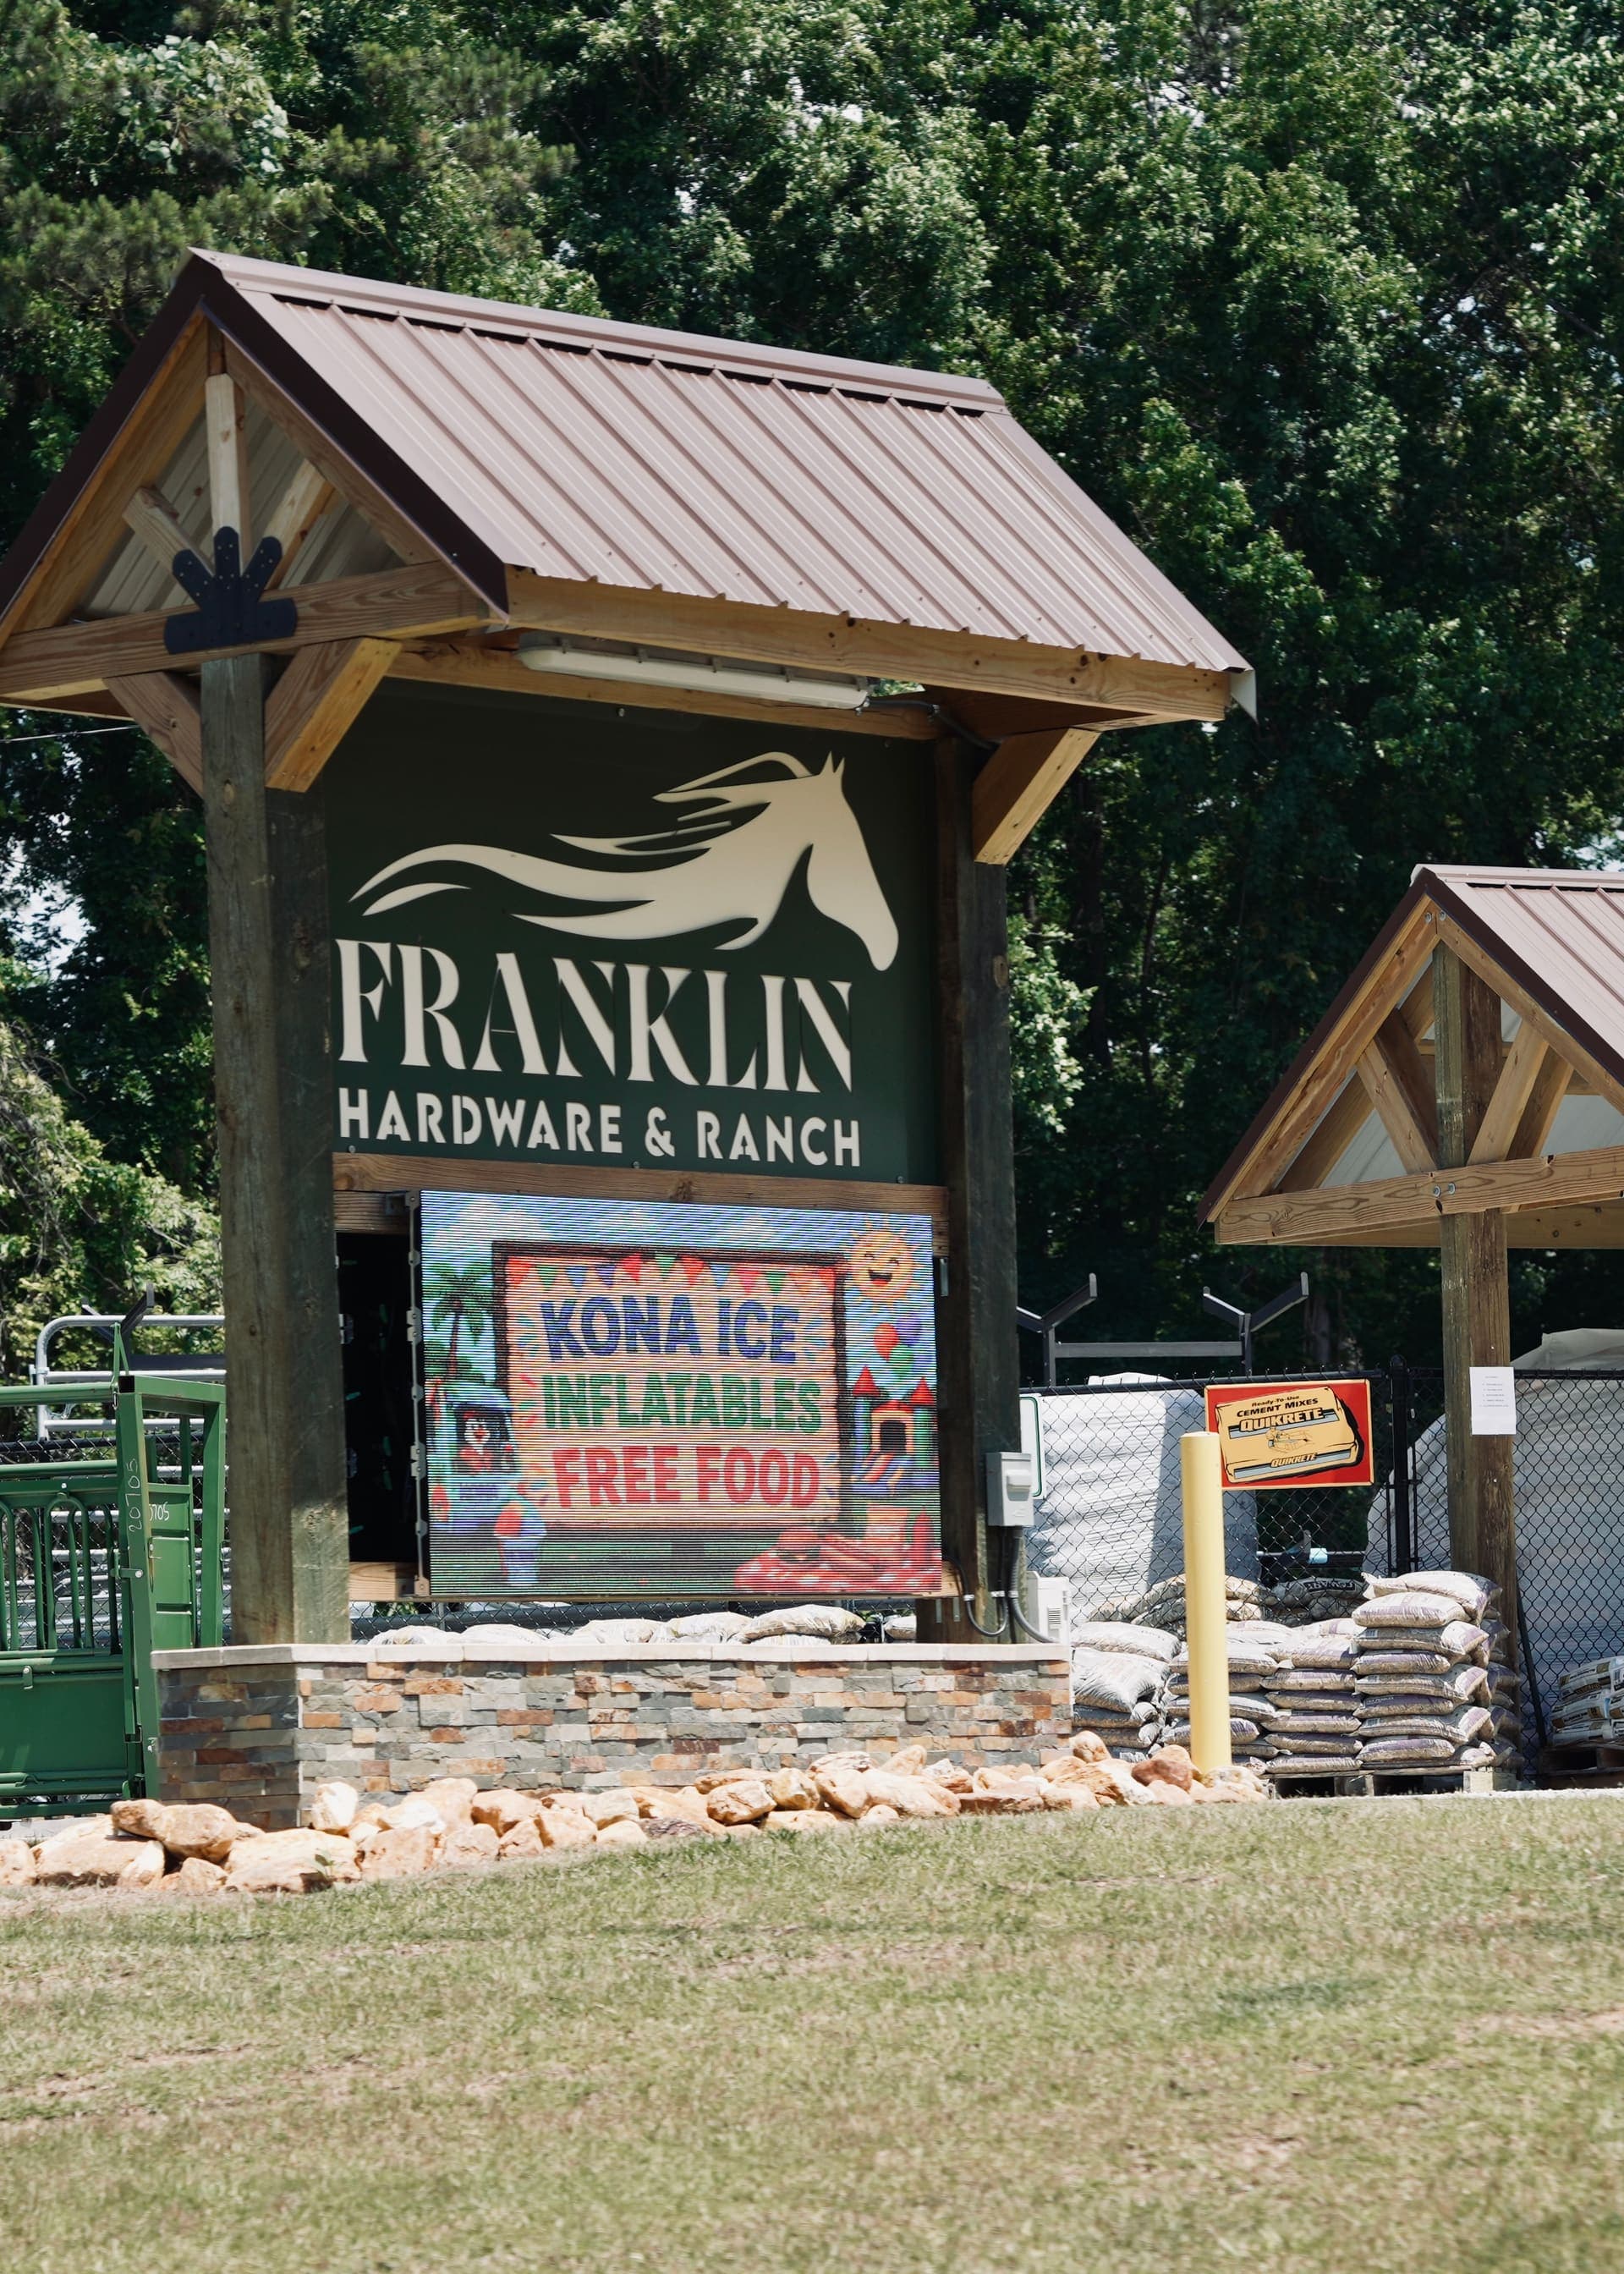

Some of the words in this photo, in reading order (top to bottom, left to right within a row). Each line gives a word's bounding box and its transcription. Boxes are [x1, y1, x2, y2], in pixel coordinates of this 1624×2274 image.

[335, 938, 853, 1093] FRANKLIN
[338, 1087, 624, 1155] HARDWARE
[644, 1107, 676, 1157] &
[695, 1110, 861, 1168] RANCH
[540, 1296, 701, 1361] KONA
[717, 1298, 799, 1364] ICE
[540, 1371, 822, 1435] INFLATABLES
[1237, 1404, 1281, 1417] CEMENT
[1285, 1398, 1318, 1409] MIXES
[1239, 1408, 1324, 1431] QUIKRETE
[1252, 1396, 1299, 1407] Ready-To-Use
[551, 1446, 682, 1509] FREE
[697, 1446, 821, 1508] FOOD
[1270, 1453, 1317, 1468] QUIKRETE
[125, 1458, 143, 1533] 20705
